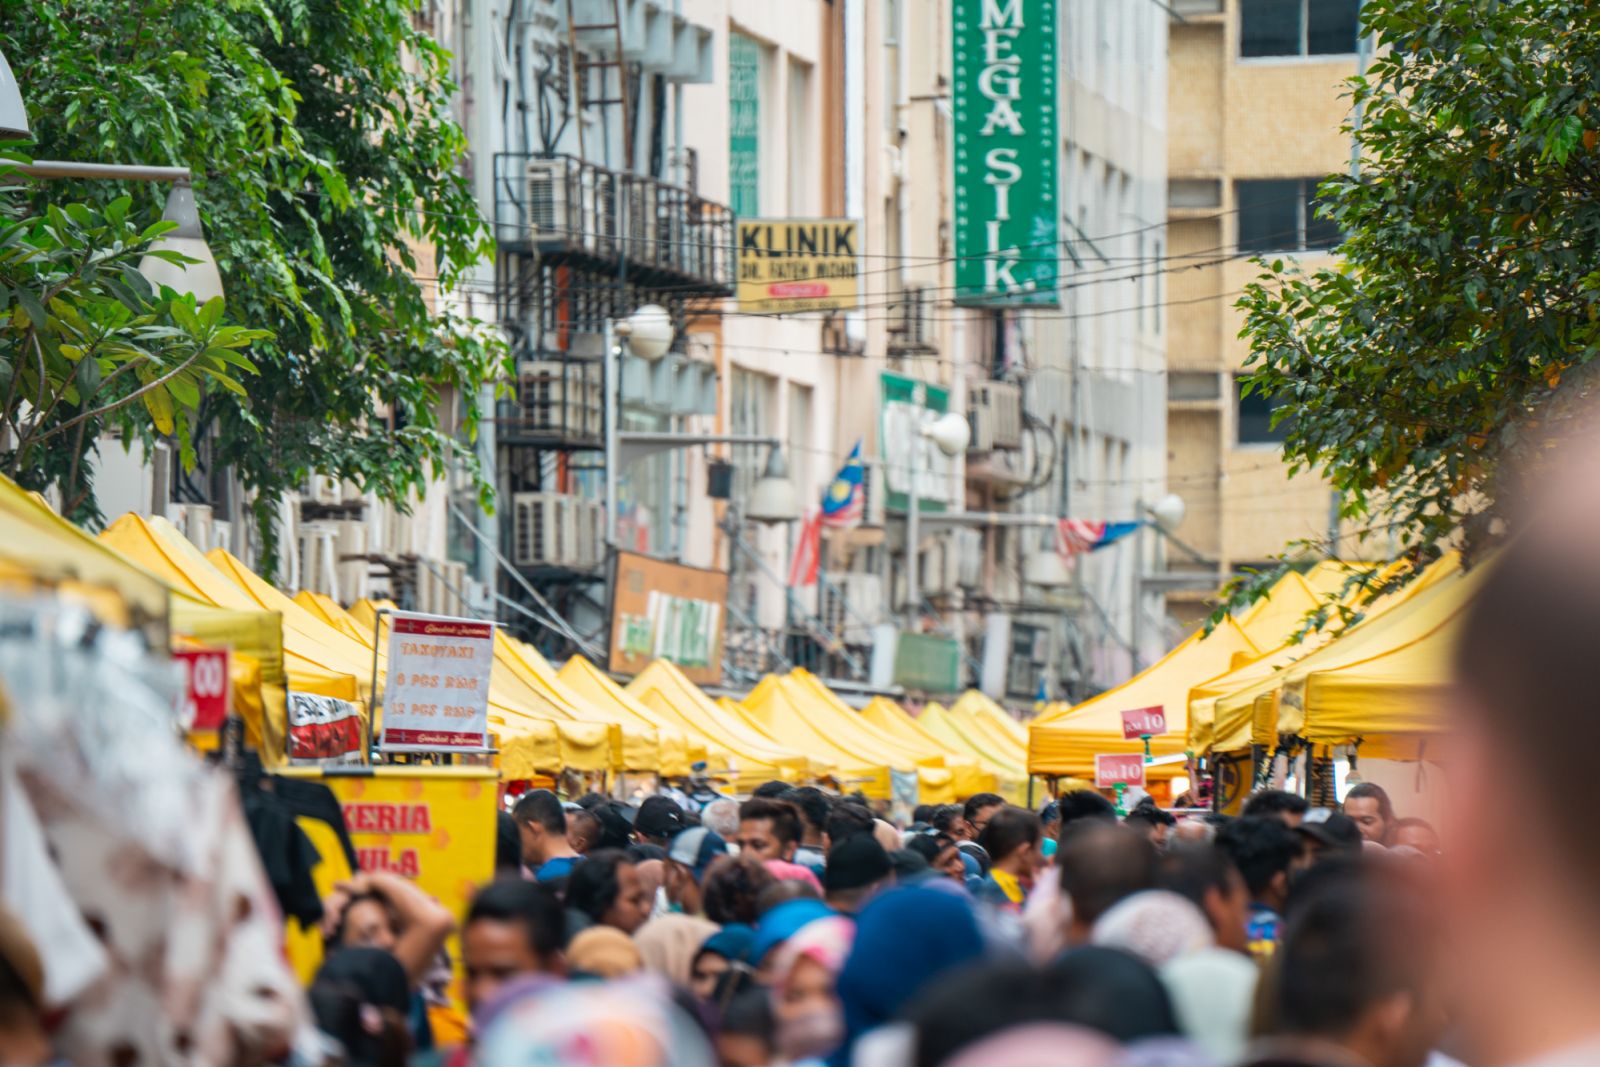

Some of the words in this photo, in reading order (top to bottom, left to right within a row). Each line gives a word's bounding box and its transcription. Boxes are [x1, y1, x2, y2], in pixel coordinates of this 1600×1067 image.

[978, 0, 1025, 136] MEGA
[741, 226, 855, 257] KLINIK
[400, 642, 475, 659] TAKOYAKI
[411, 674, 439, 689] PCS
[411, 703, 438, 717] PCS
